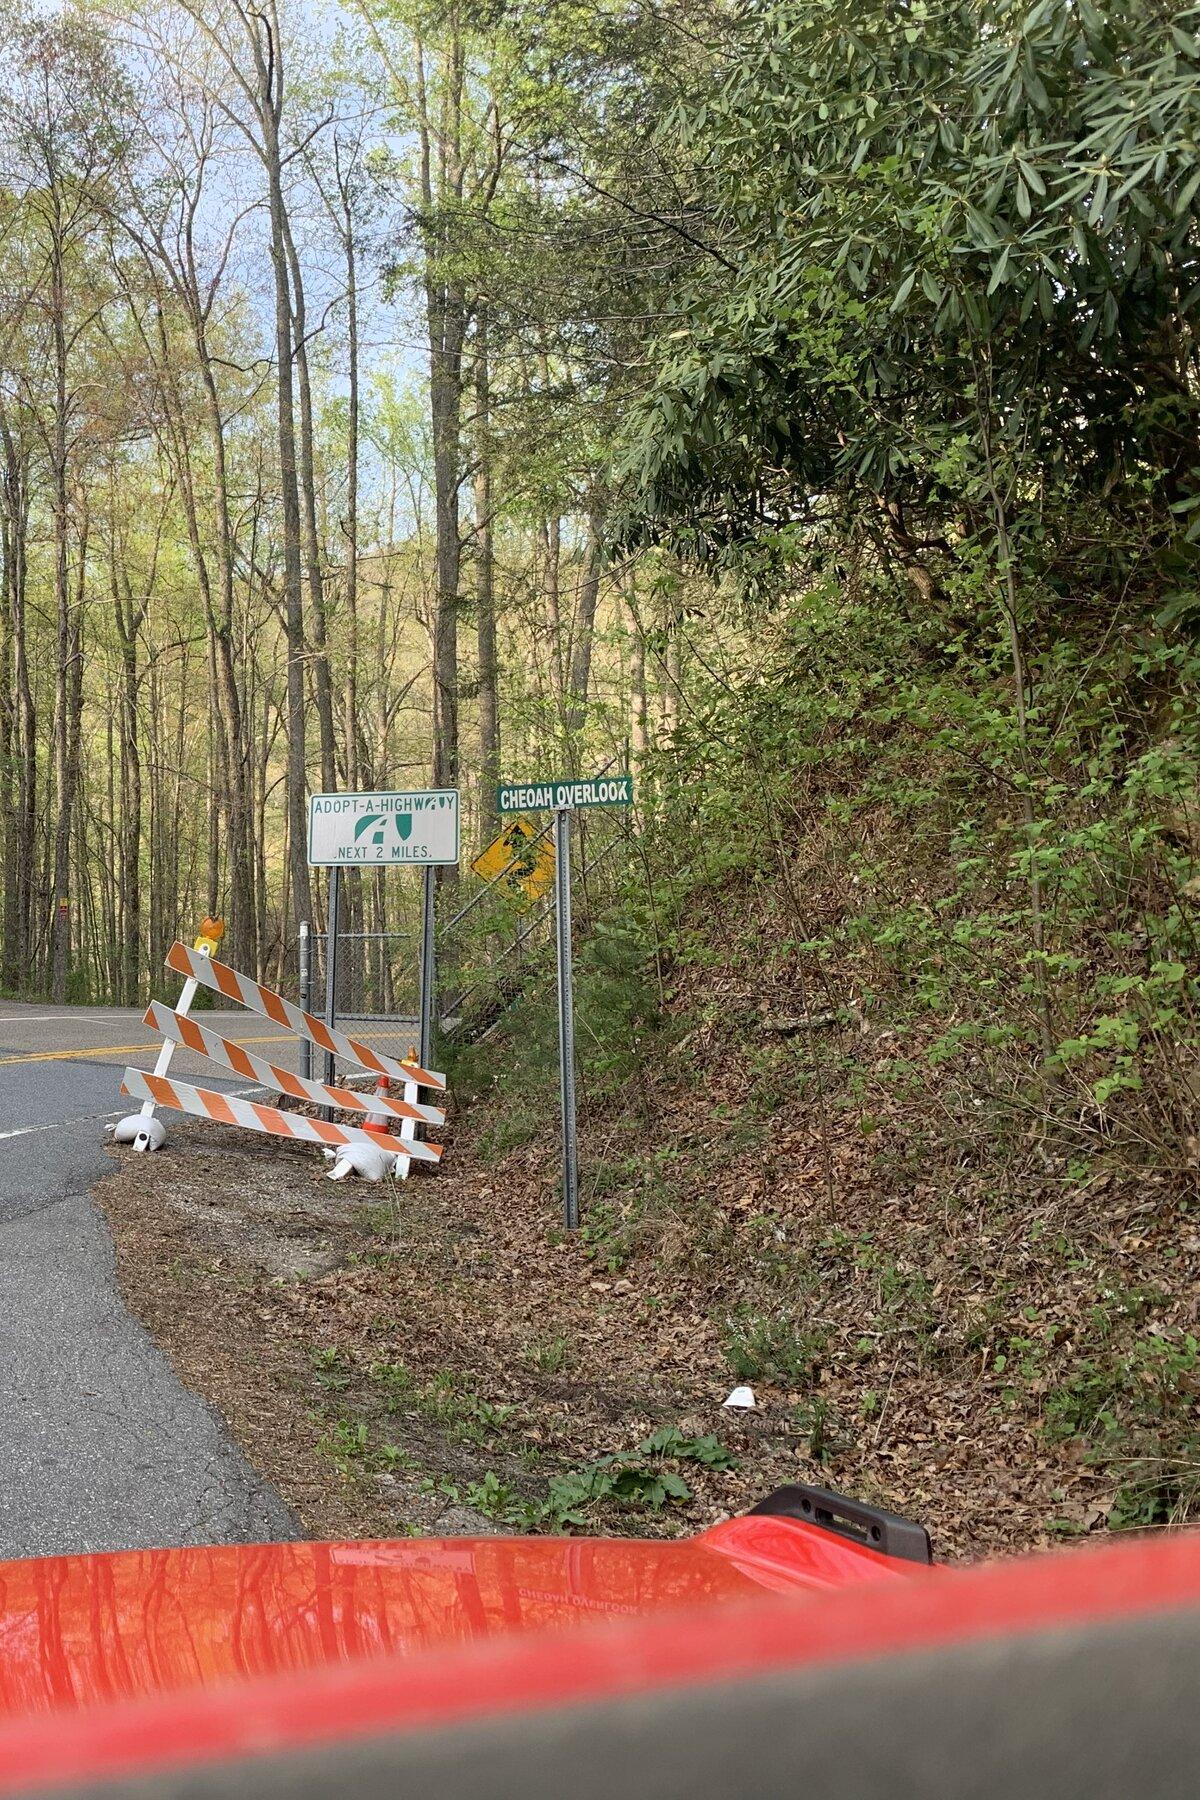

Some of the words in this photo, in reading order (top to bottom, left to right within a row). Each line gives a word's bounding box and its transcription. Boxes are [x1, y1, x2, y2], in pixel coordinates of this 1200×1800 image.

[501, 787, 553, 809] CHEOAH
[556, 781, 628, 806] OVERLOOK
[338, 847, 367, 859] NEXT
[376, 846, 384, 859] 2
